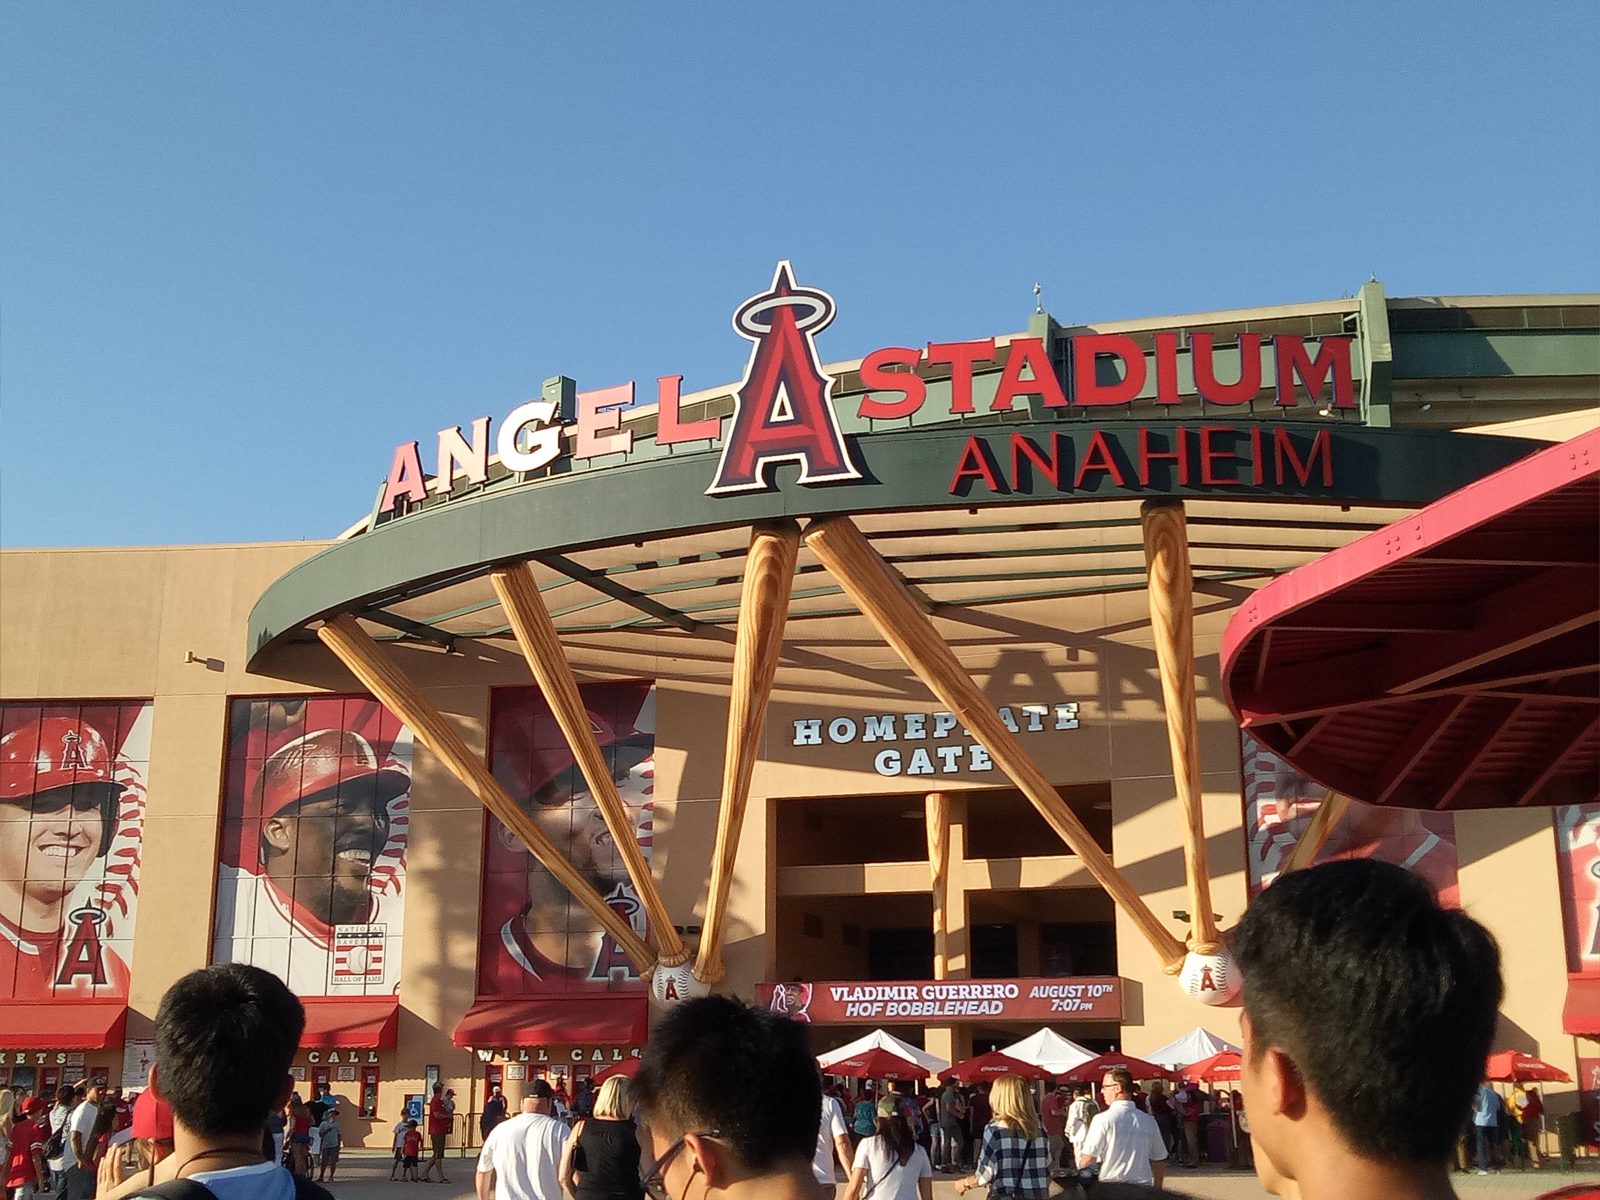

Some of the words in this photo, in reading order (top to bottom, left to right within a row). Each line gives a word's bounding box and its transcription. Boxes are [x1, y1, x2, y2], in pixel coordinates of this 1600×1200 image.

[703, 260, 863, 497] A
[381, 375, 721, 512] ANGEL
[857, 332, 1360, 420] STADIUM
[949, 426, 1332, 495] ANAHEIM
[793, 703, 1080, 746] HOMEPATE
[874, 745, 993, 776] GATE
[830, 986, 919, 1001] VLADIMIR
[922, 984, 1019, 1000] GUERRERO
[1029, 985, 1085, 998] AUGUST
[846, 1002, 883, 1017] HOF
[885, 1001, 1004, 1016] BOBBLEHEAD
[308, 1051, 378, 1063] CALL
[477, 1049, 548, 1062] WILL
